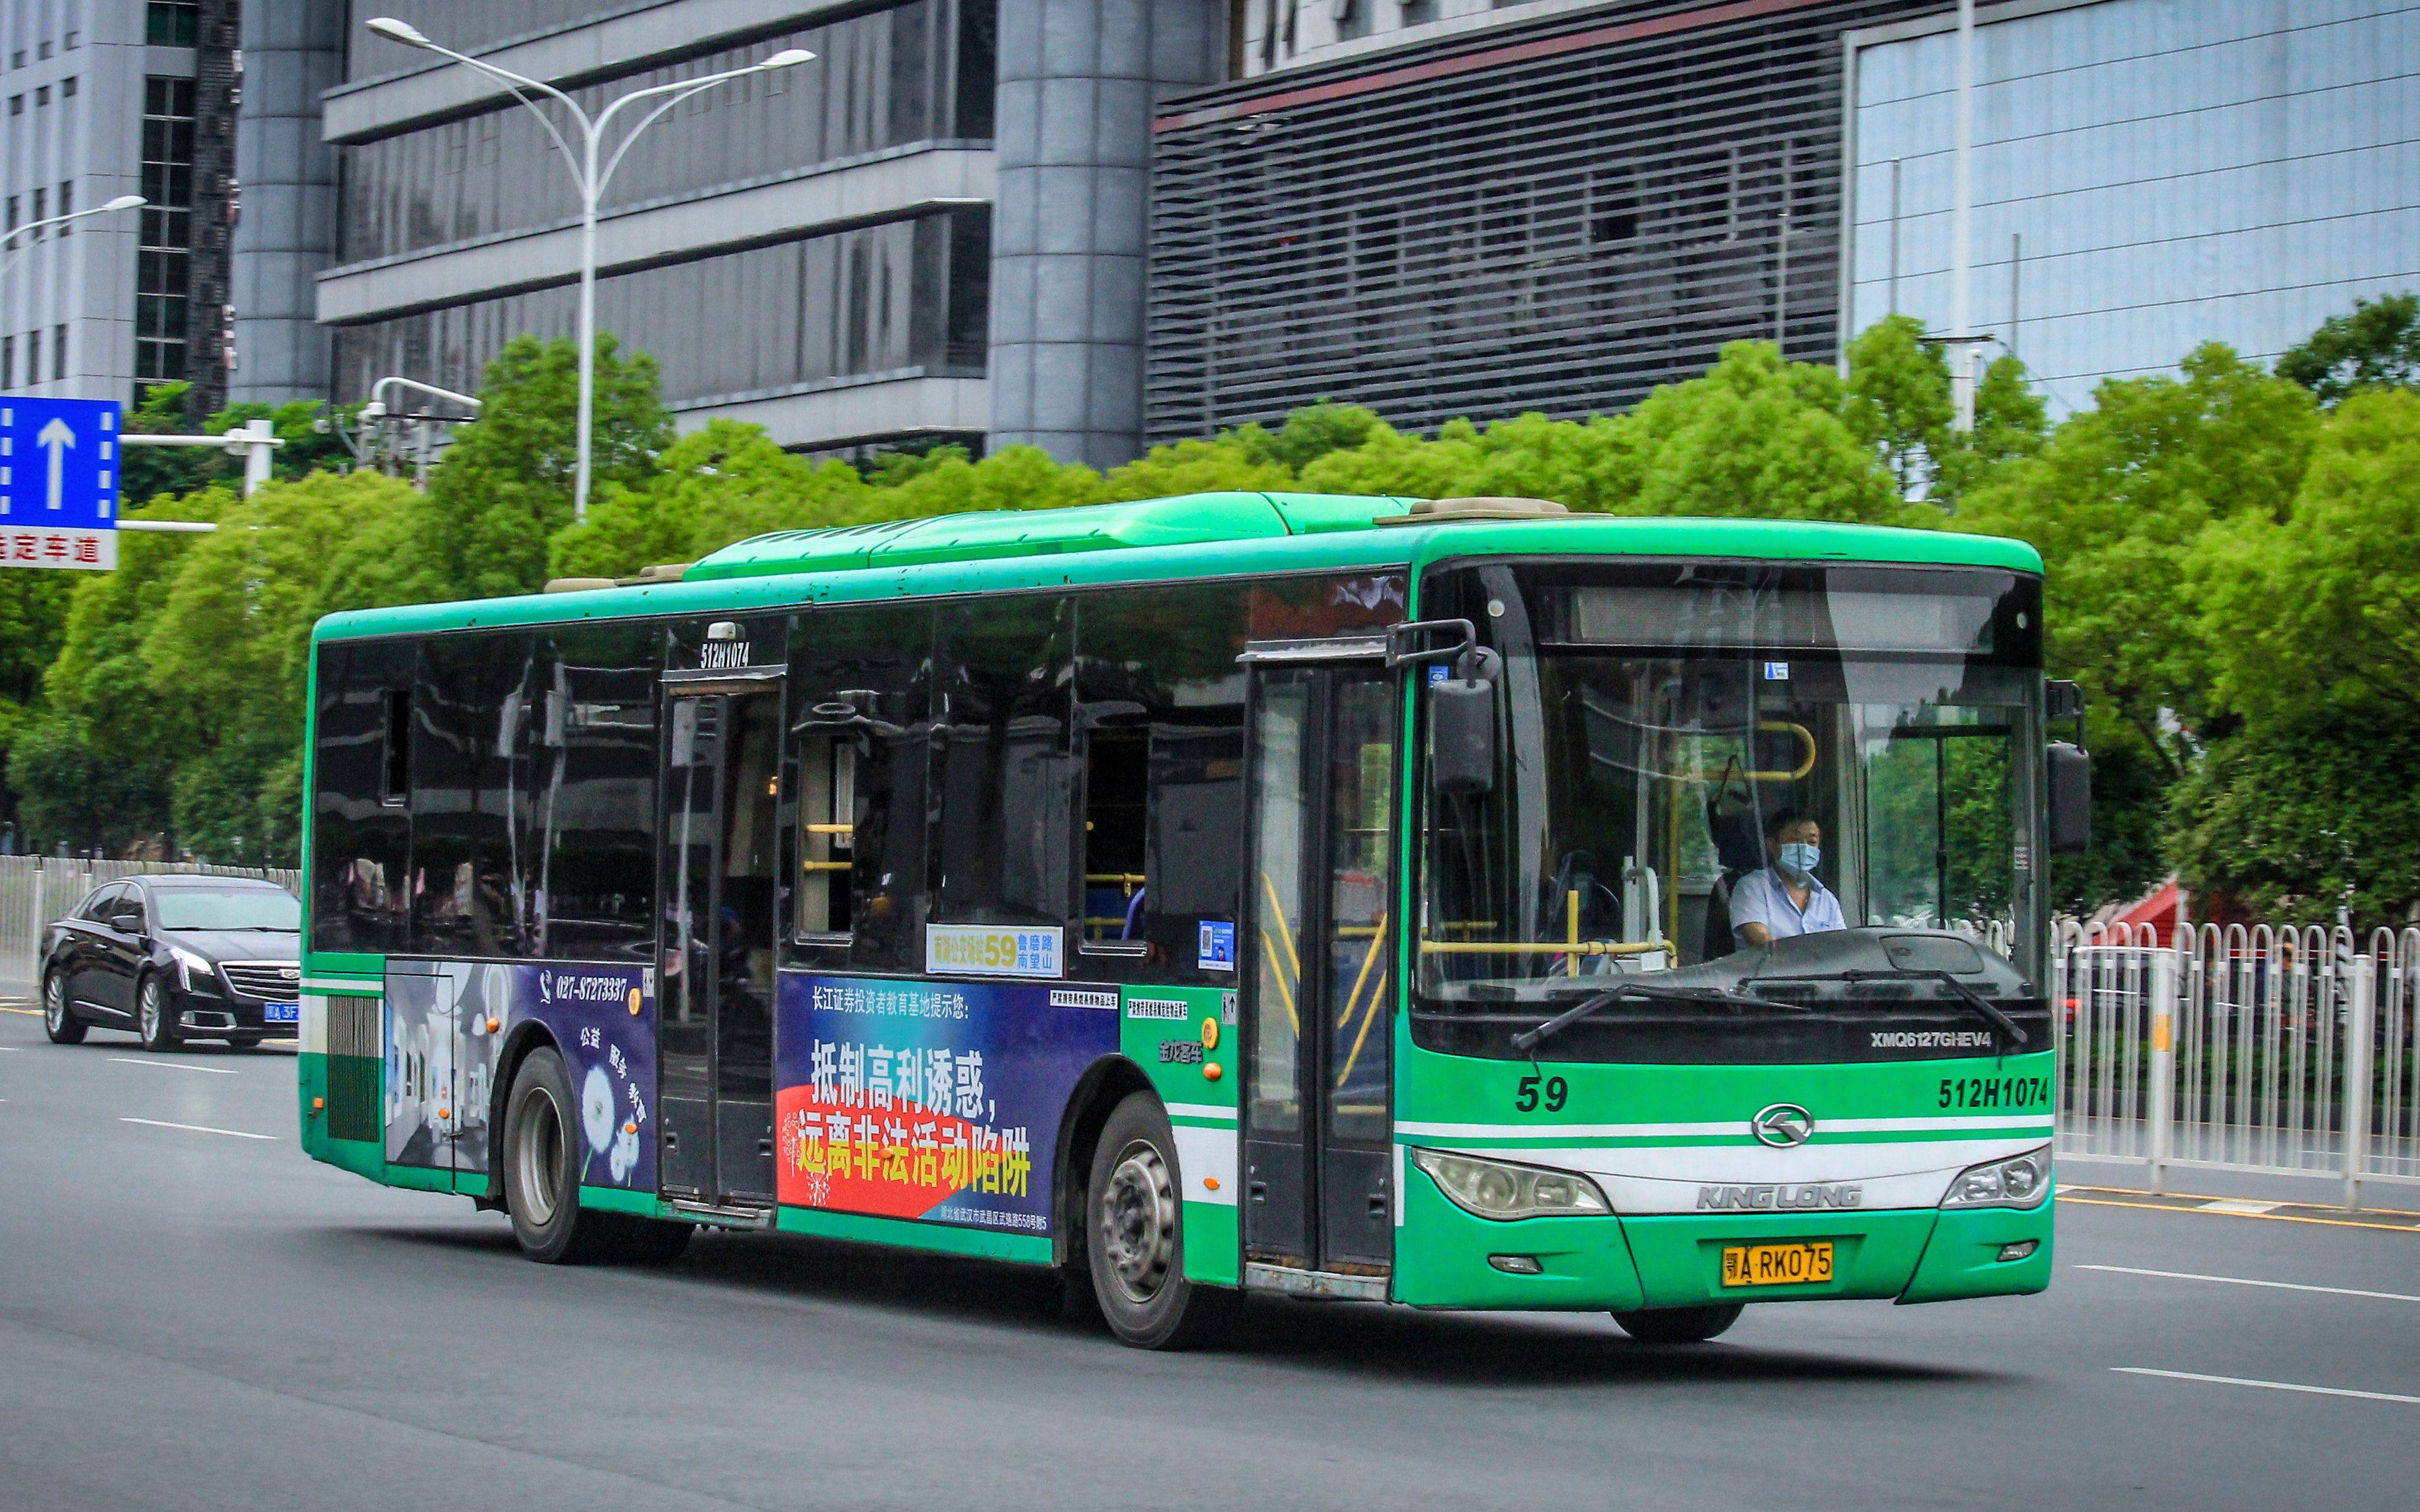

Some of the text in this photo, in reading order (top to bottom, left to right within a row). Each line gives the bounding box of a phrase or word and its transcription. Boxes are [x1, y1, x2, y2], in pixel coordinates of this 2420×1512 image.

[700, 641, 750, 669] 512H1074
[984, 934, 1017, 967] 59
[1017, 933, 1053, 952] 鲁磨路
[1017, 953, 1053, 969] 南望山
[556, 975, 627, 1002] 027-87273337
[1871, 1032, 1992, 1047] XMQ6127GHEV4
[1515, 1076, 1568, 1112] 59
[1939, 1078, 2048, 1108] 512H1074
[797, 1108, 1031, 1197] 远离非法活动陷阱
[1697, 1185, 1862, 1208] KING LONG
